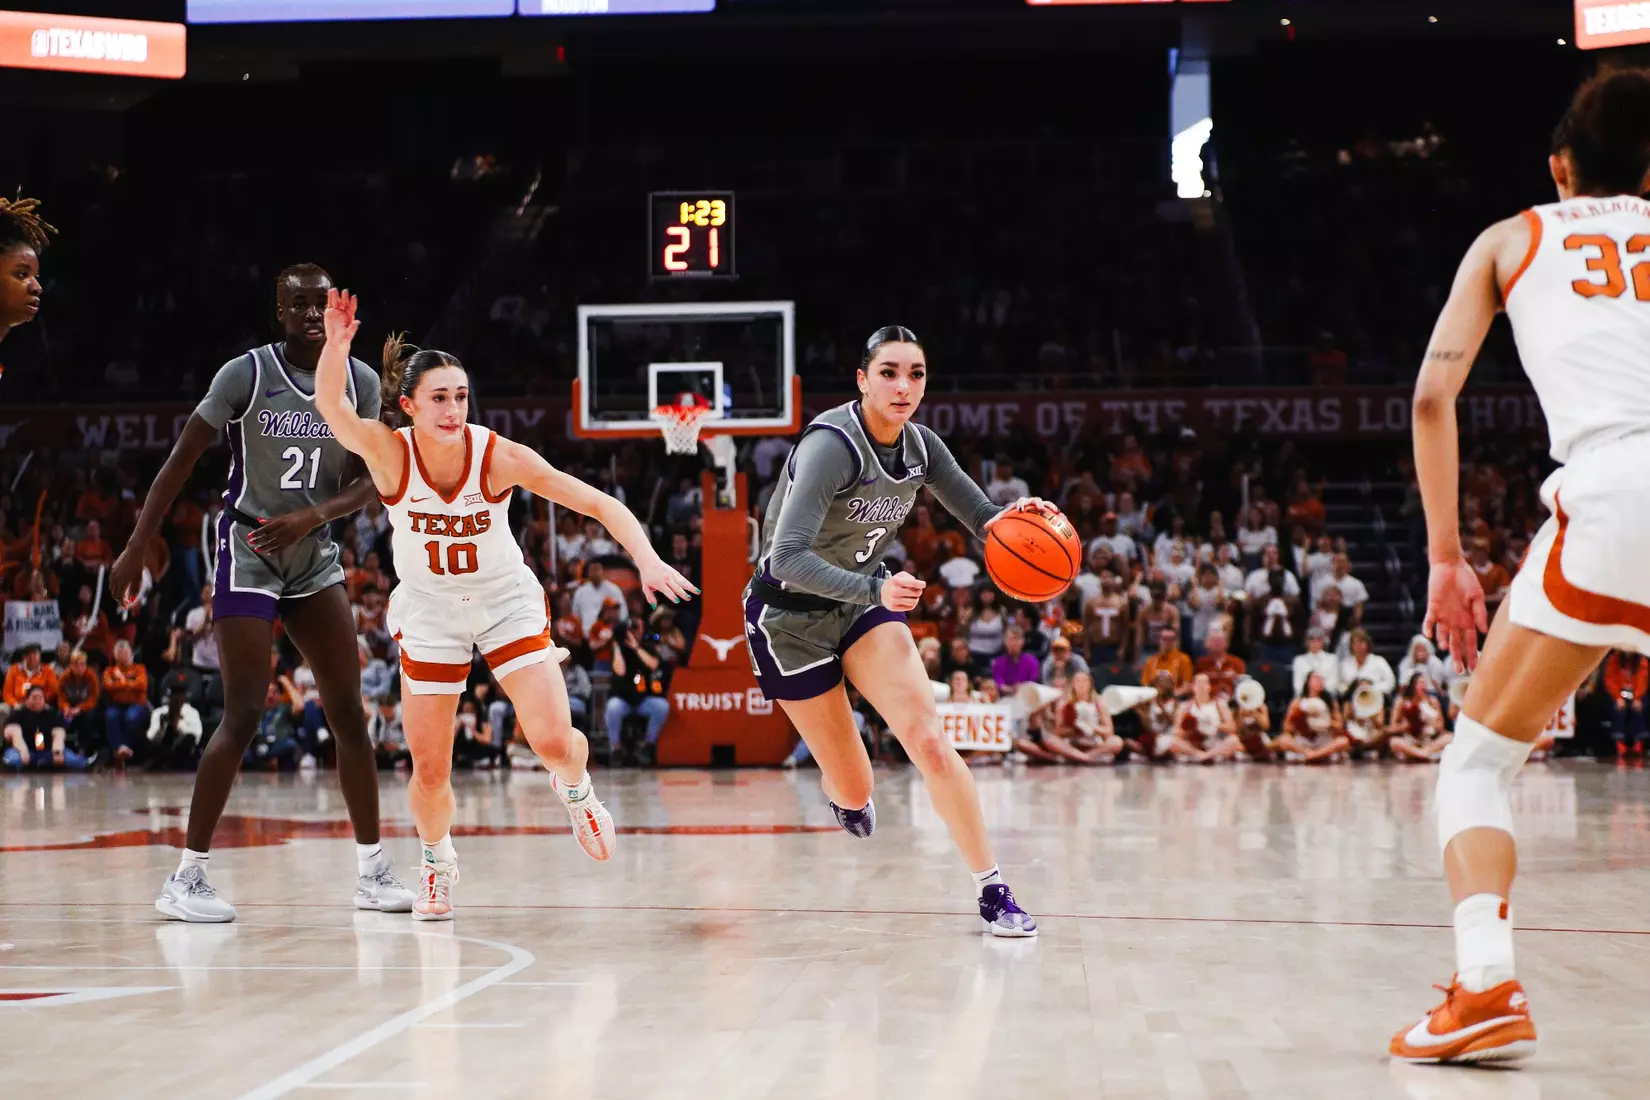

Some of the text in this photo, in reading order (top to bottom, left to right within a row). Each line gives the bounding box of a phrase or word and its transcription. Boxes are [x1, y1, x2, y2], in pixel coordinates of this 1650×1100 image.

[680, 199, 726, 226] 1:23
[664, 226, 719, 271] 21
[258, 409, 335, 439] Wildca
[1205, 398, 1342, 433] TEXAS
[280, 445, 322, 490] 21
[407, 509, 492, 538] TEXAS
[424, 540, 479, 576] 10
[854, 526, 888, 565] 3
[674, 692, 745, 711] TRUIST
